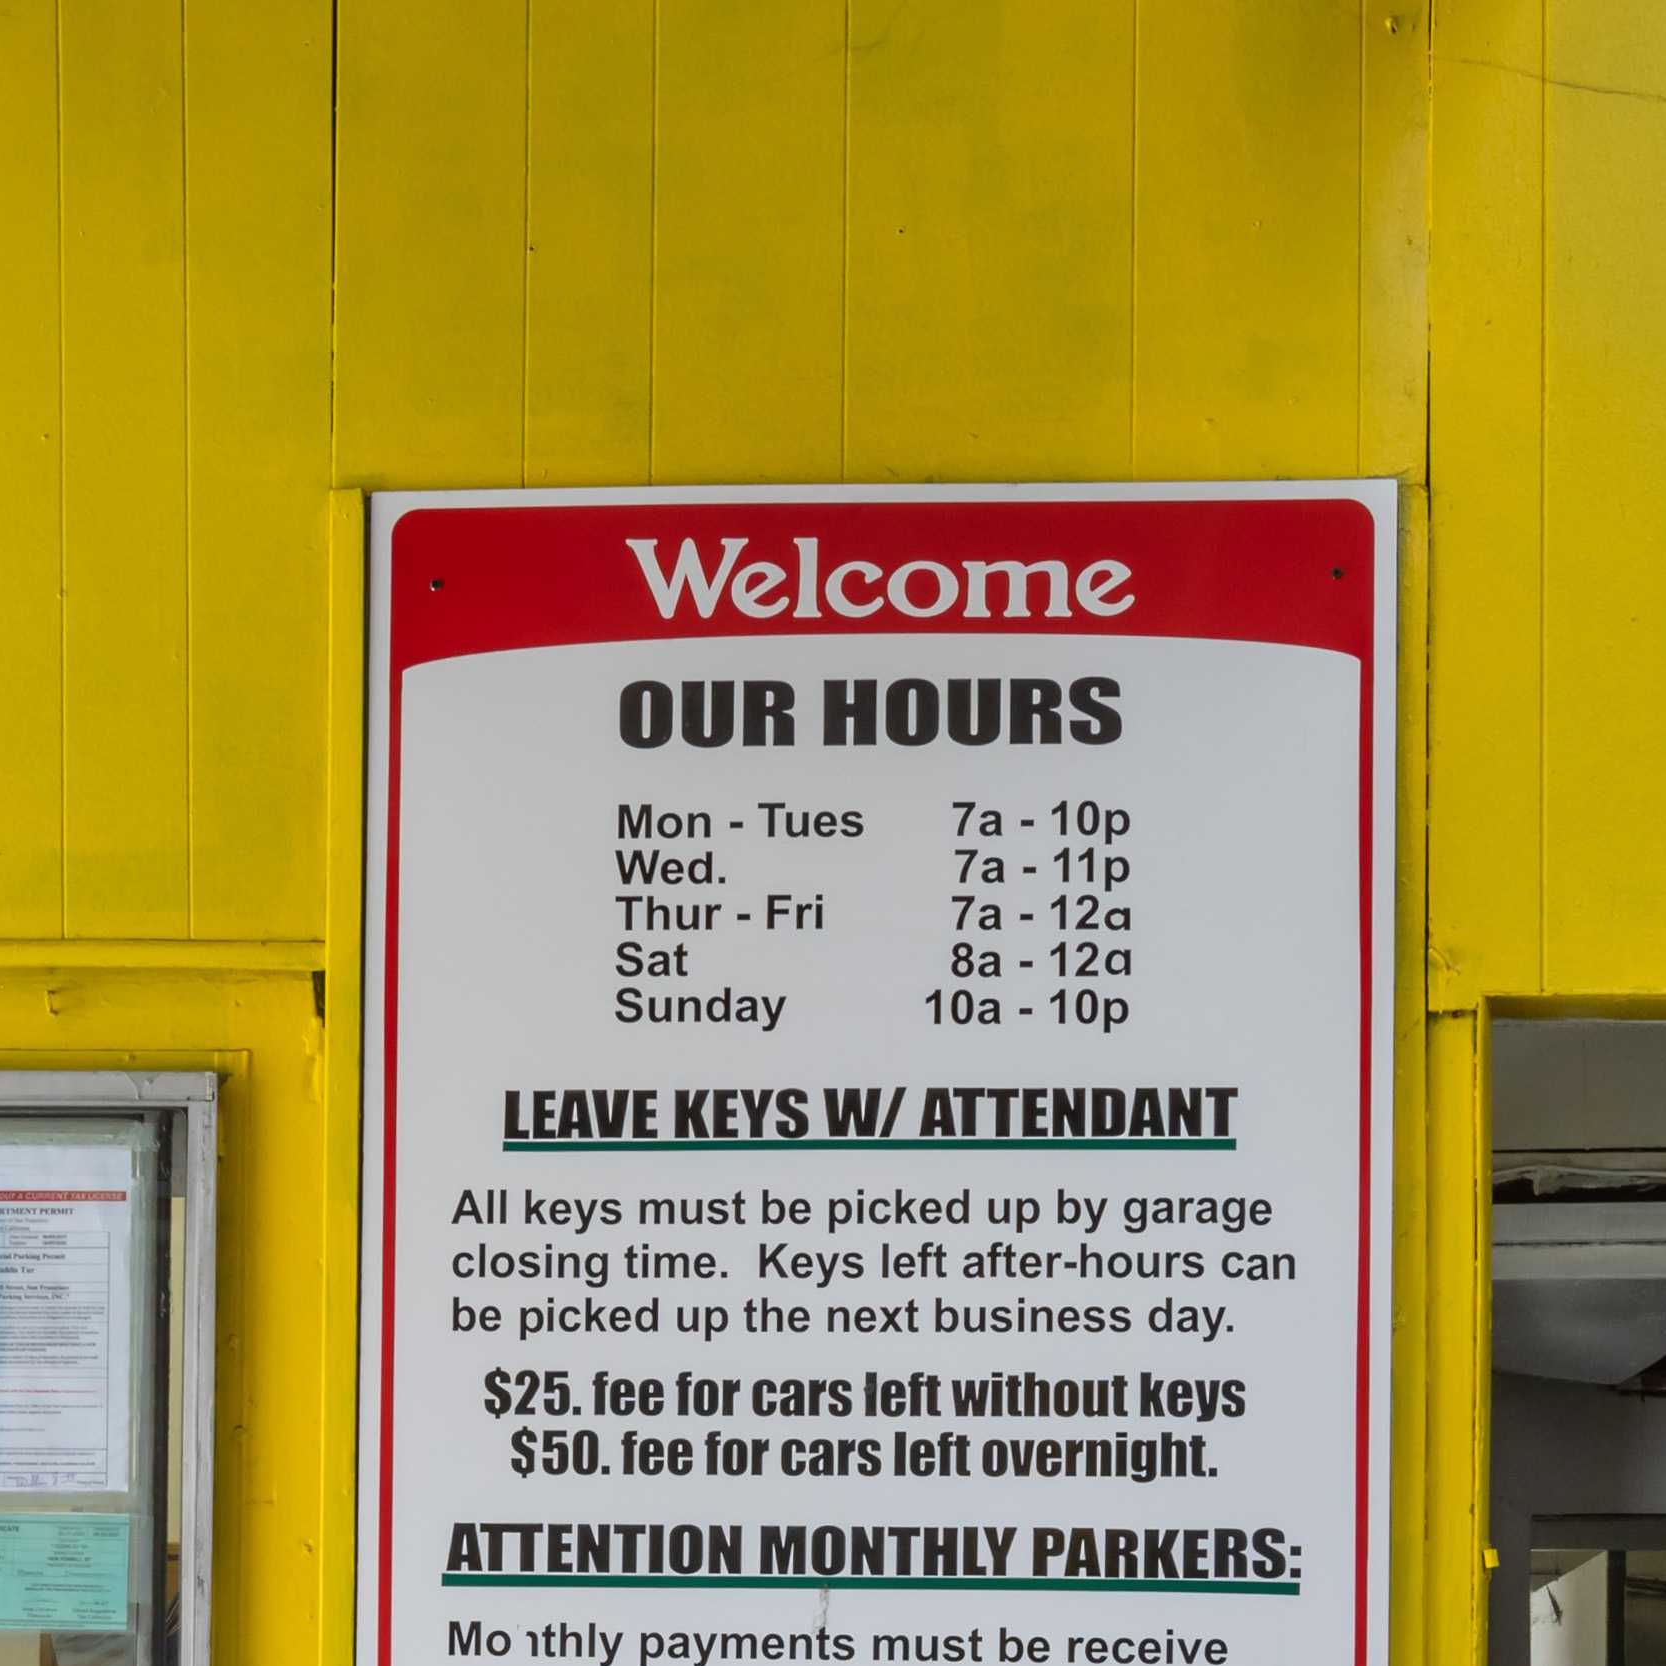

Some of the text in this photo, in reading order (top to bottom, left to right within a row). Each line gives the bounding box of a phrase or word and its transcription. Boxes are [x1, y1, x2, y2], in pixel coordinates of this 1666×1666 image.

[626, 537, 1135, 619] Welcome
[620, 677, 1122, 749] OUR HOURS
[618, 804, 711, 839] Mon
[758, 803, 863, 837] Tues
[953, 802, 1002, 836] 7a
[1052, 801, 1130, 845] 10p
[615, 850, 725, 884] Wed.
[955, 849, 1004, 883] 7a
[1054, 847, 1130, 890] 11p
[504, 1087, 1239, 1139] LEAVE KEYS W/ ATTENDANT
[39, 1207, 75, 1216] PERMIT
[452, 1189, 1272, 1234] All keys must be picked up by garage
[446, 1523, 1303, 1580] ATTENTION MONTHLY PARKERS:
